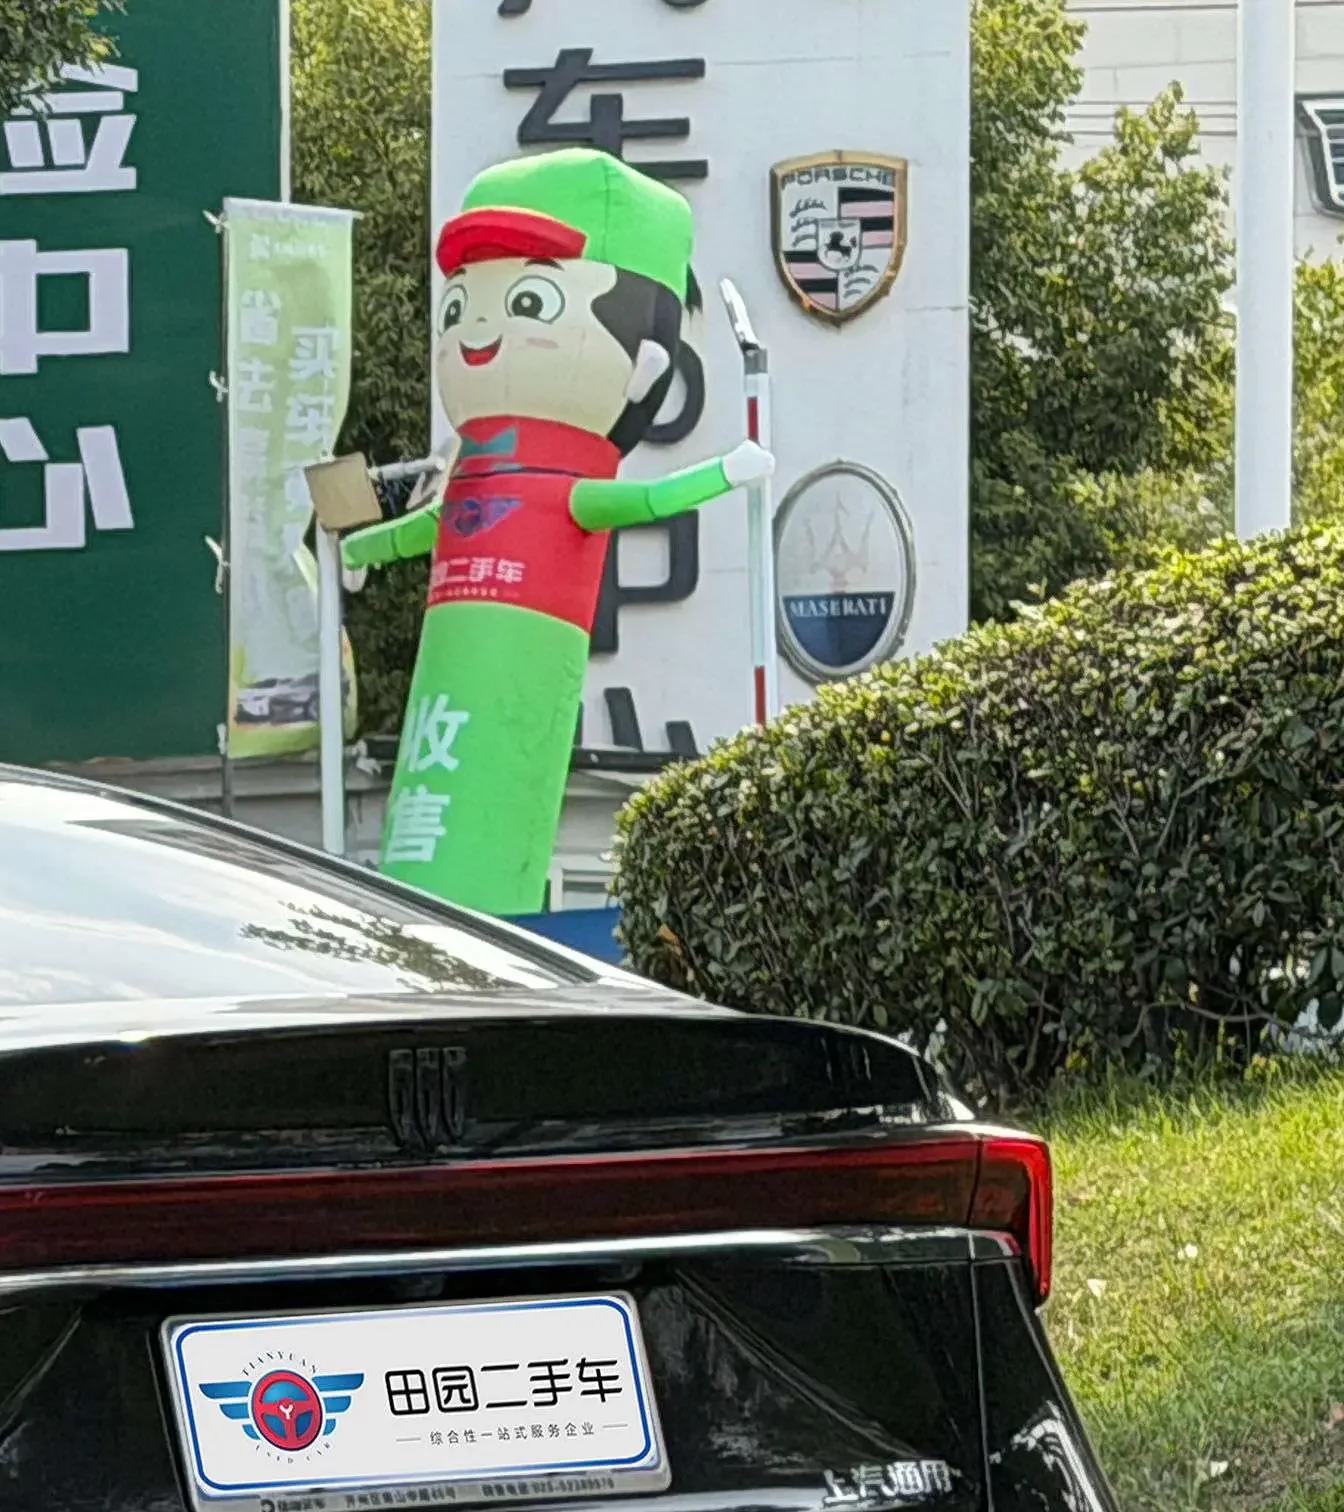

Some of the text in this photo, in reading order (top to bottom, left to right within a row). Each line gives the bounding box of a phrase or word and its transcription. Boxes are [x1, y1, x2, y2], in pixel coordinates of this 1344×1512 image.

[788, 597, 887, 617] MASERATI
[384, 1357, 624, 1416] 田园二手车
[429, 1420, 596, 1446] 综合性一站式服务企业
